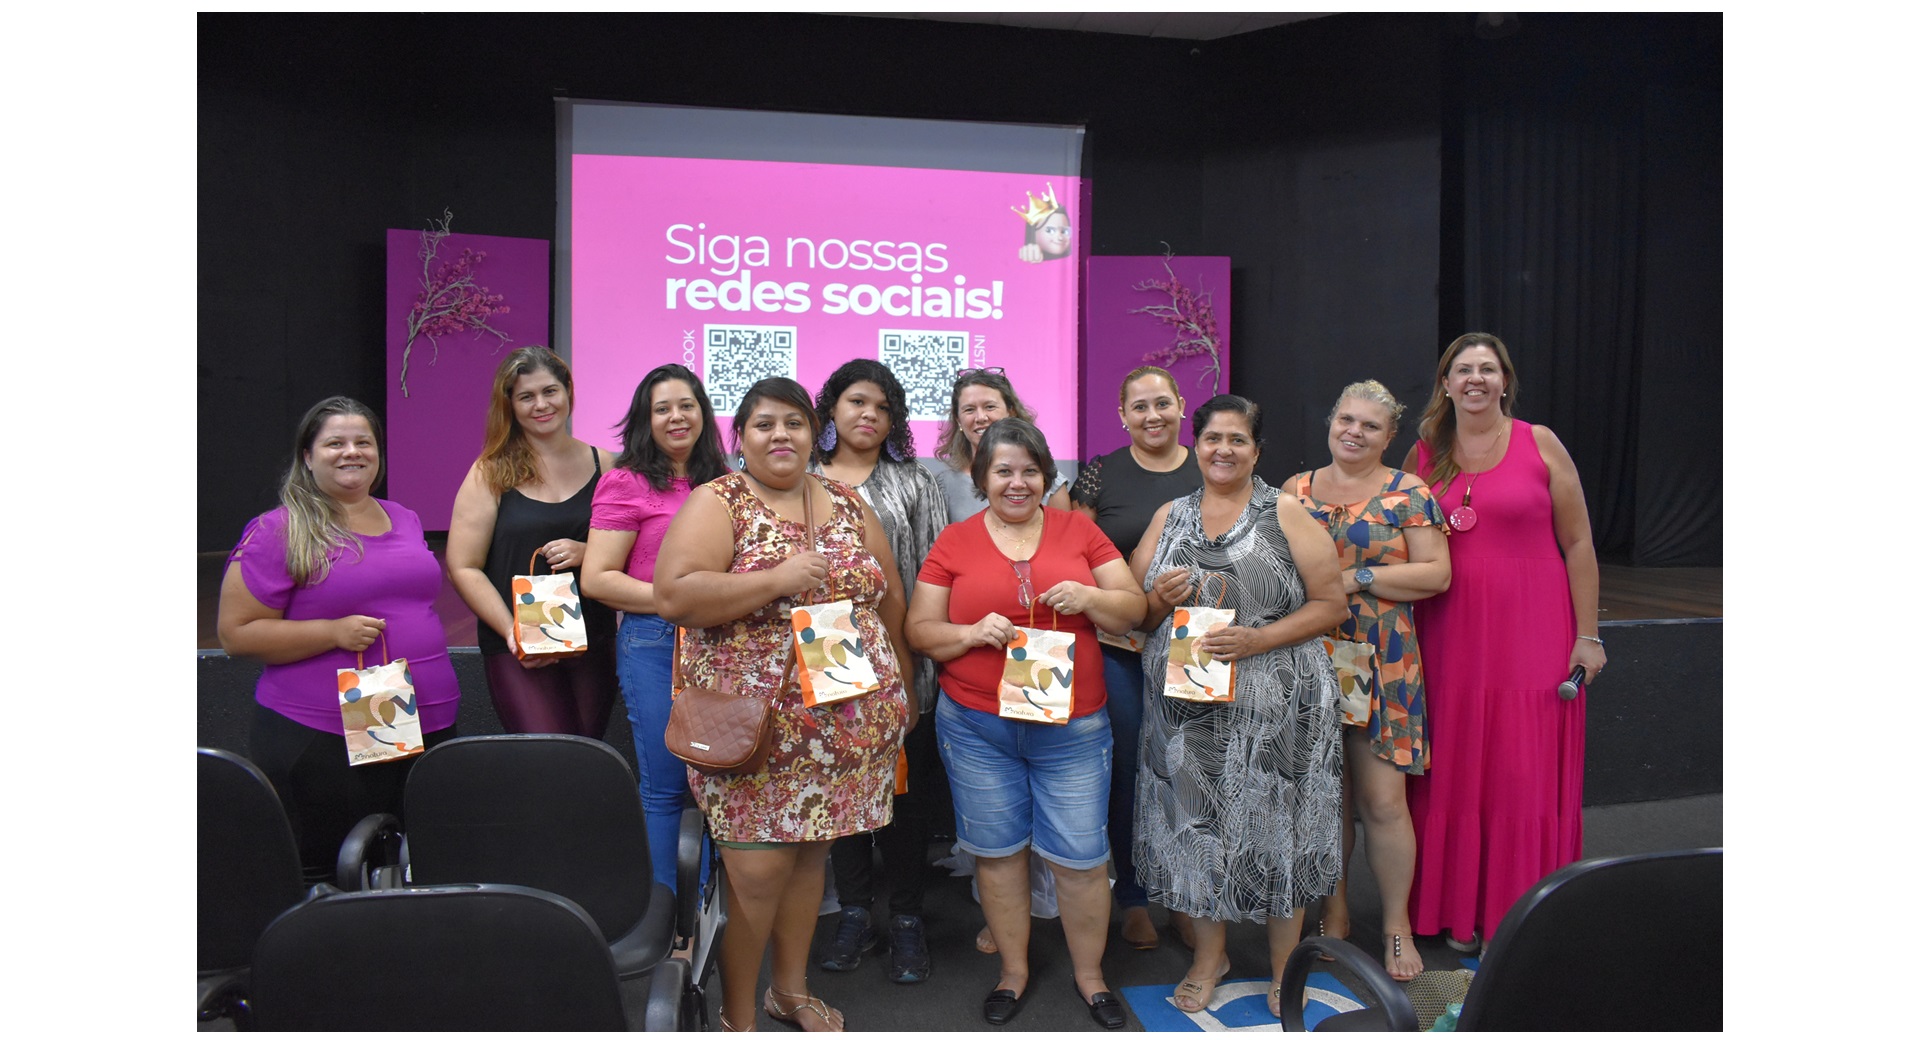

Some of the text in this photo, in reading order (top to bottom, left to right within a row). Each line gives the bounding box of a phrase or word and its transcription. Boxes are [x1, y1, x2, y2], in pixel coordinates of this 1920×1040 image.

[665, 222, 948, 276] Siga nossas
[666, 269, 1004, 320] redes sociais!
